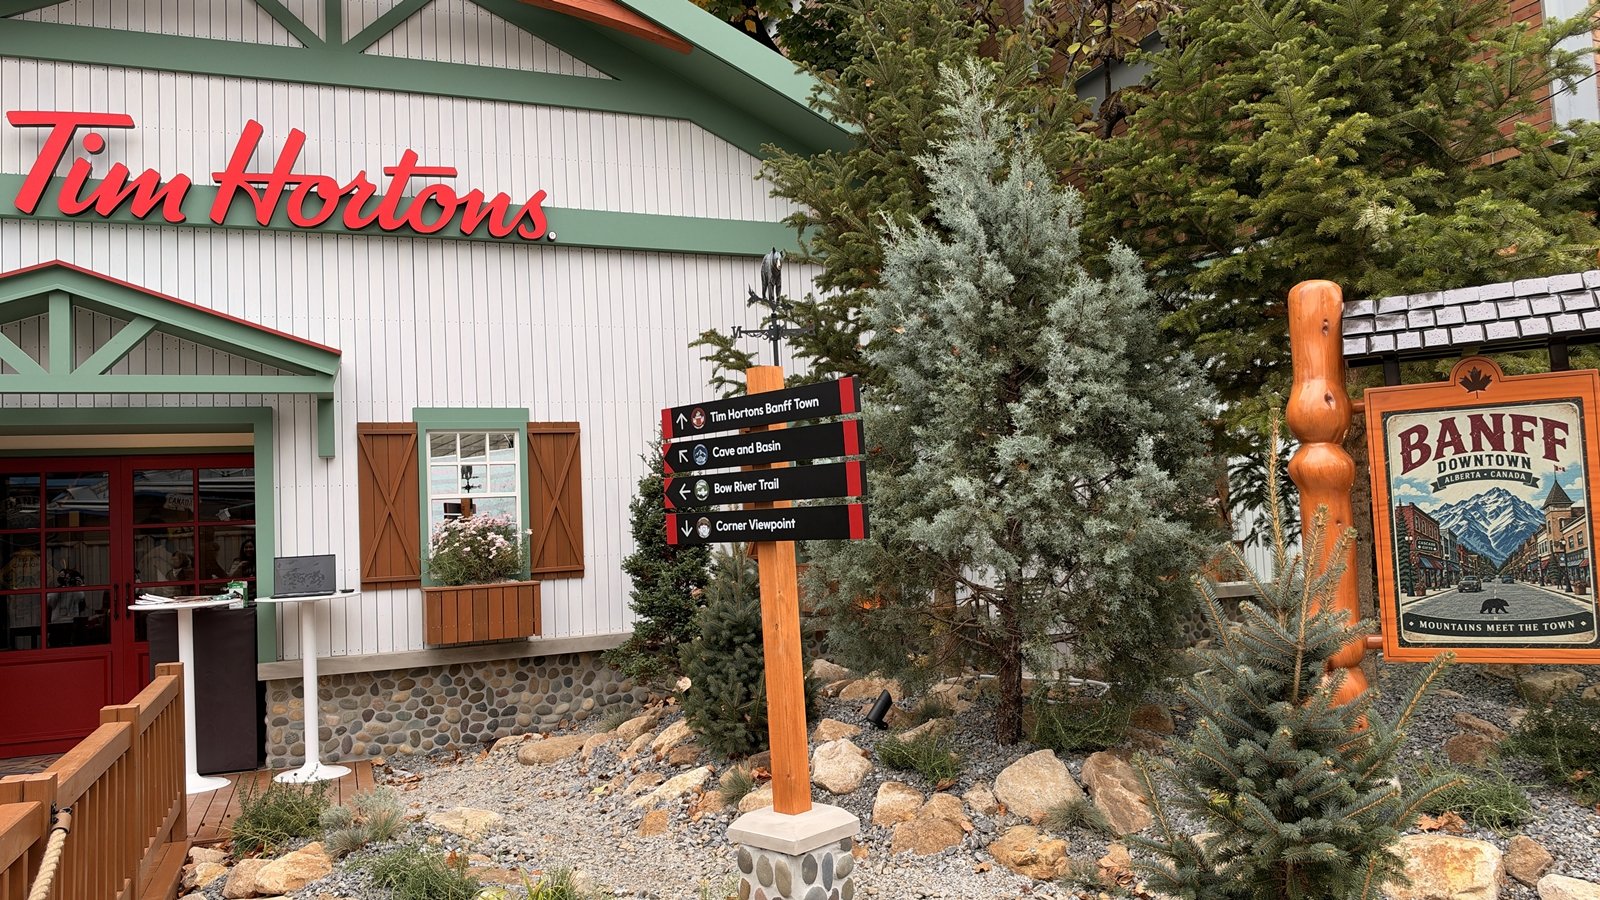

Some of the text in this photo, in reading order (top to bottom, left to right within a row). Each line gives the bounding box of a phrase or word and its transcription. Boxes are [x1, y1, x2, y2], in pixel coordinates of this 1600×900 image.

[7, 111, 547, 240] Tim Hortons
[710, 397, 820, 423] Tim Hortons Banff Town
[712, 440, 781, 458] Cave and Basin
[1398, 413, 1569, 475] BANFF
[1437, 454, 1531, 474] DOWNTOWN
[714, 478, 779, 494] Bow River Trail
[1444, 471, 1526, 484] ALBERTA CANADA
[716, 517, 796, 533] Corner Viewpoint
[1419, 620, 1575, 632] MOUNTAINS MEET THE TOWN
